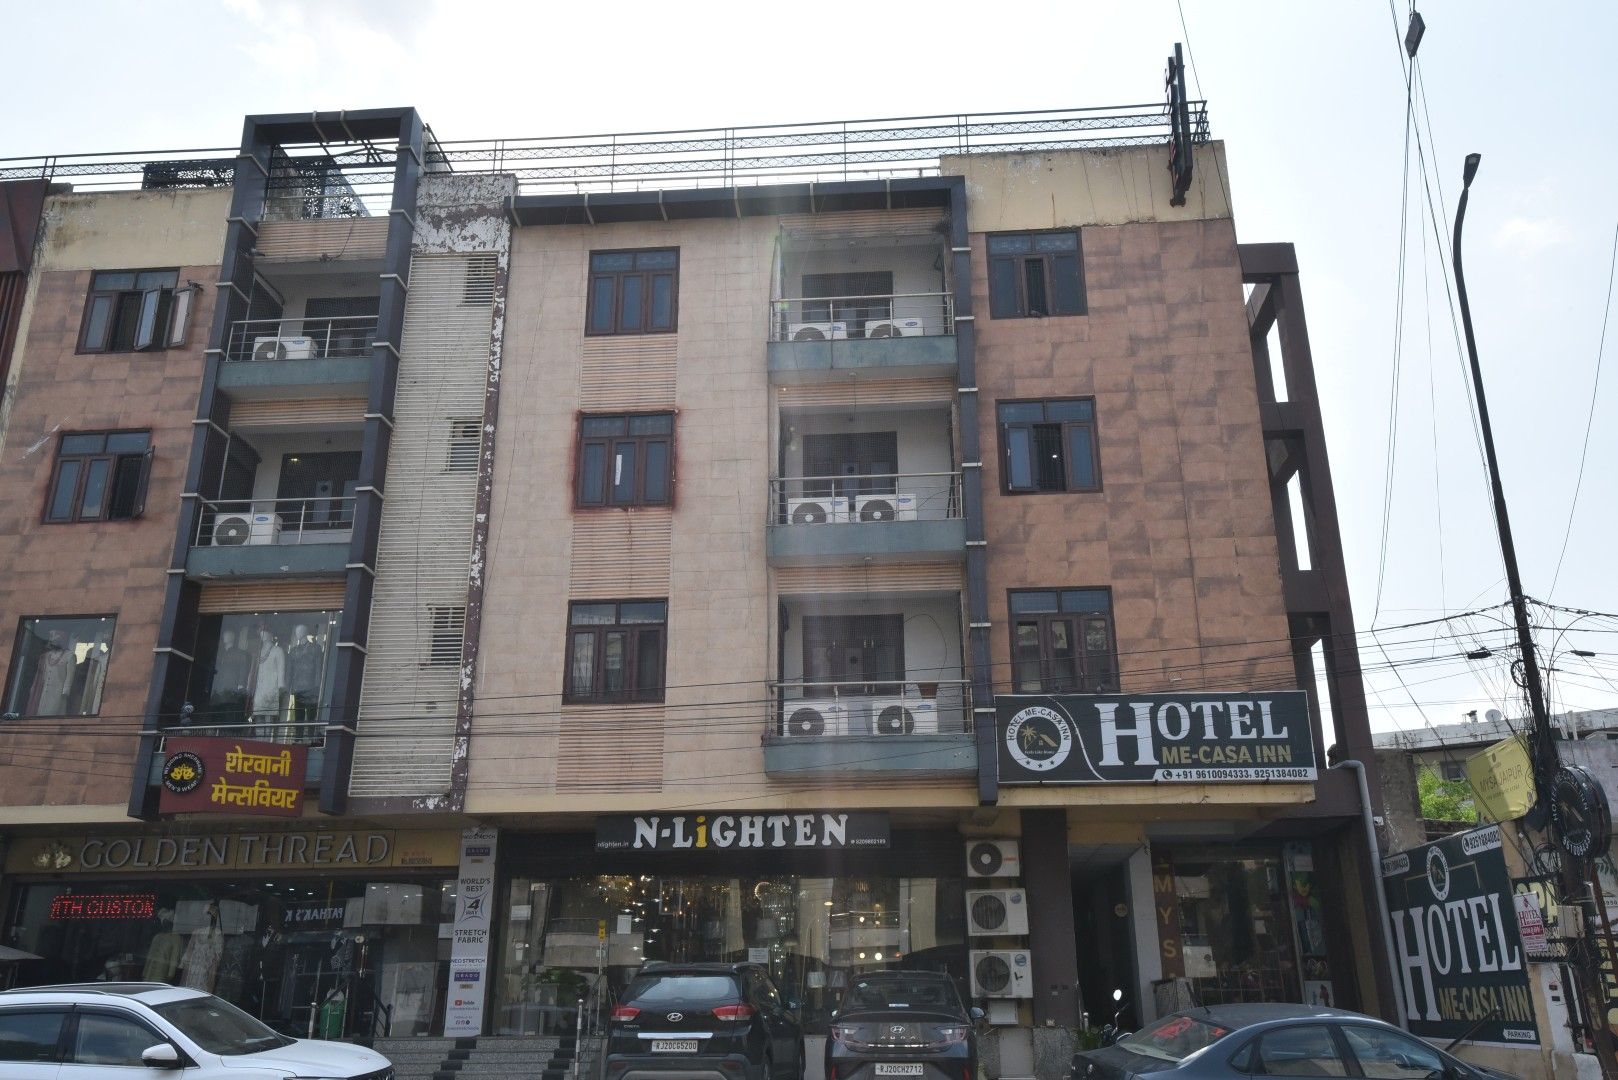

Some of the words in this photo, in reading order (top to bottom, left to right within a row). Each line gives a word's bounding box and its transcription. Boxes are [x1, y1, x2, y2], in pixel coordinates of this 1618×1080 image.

[1007, 715, 1024, 741] HOTEL
[1024, 707, 1063, 725] ME-CASA
[1060, 724, 1070, 741] INN
[1094, 701, 1289, 766] HOTEL
[225, 745, 291, 777] शेरवानी
[1161, 745, 1253, 765] ME-CASA
[1255, 744, 1292, 763] INN
[1175, 770, 1193, 780] +91
[1254, 768, 1309, 779] 9251384082
[211, 776, 299, 809] मेन्सवियर
[80, 837, 228, 868] GOLDEN
[238, 834, 389, 866] THREAD
[460, 877, 491, 885] WORLD'S
[467, 898, 480, 910] 4
[1391, 892, 1522, 1022] HOTEL
[1438, 985, 1500, 1021] ME-CASA
[1500, 985, 1533, 1022] INN
[1506, 1030, 1532, 1039] PARKING
